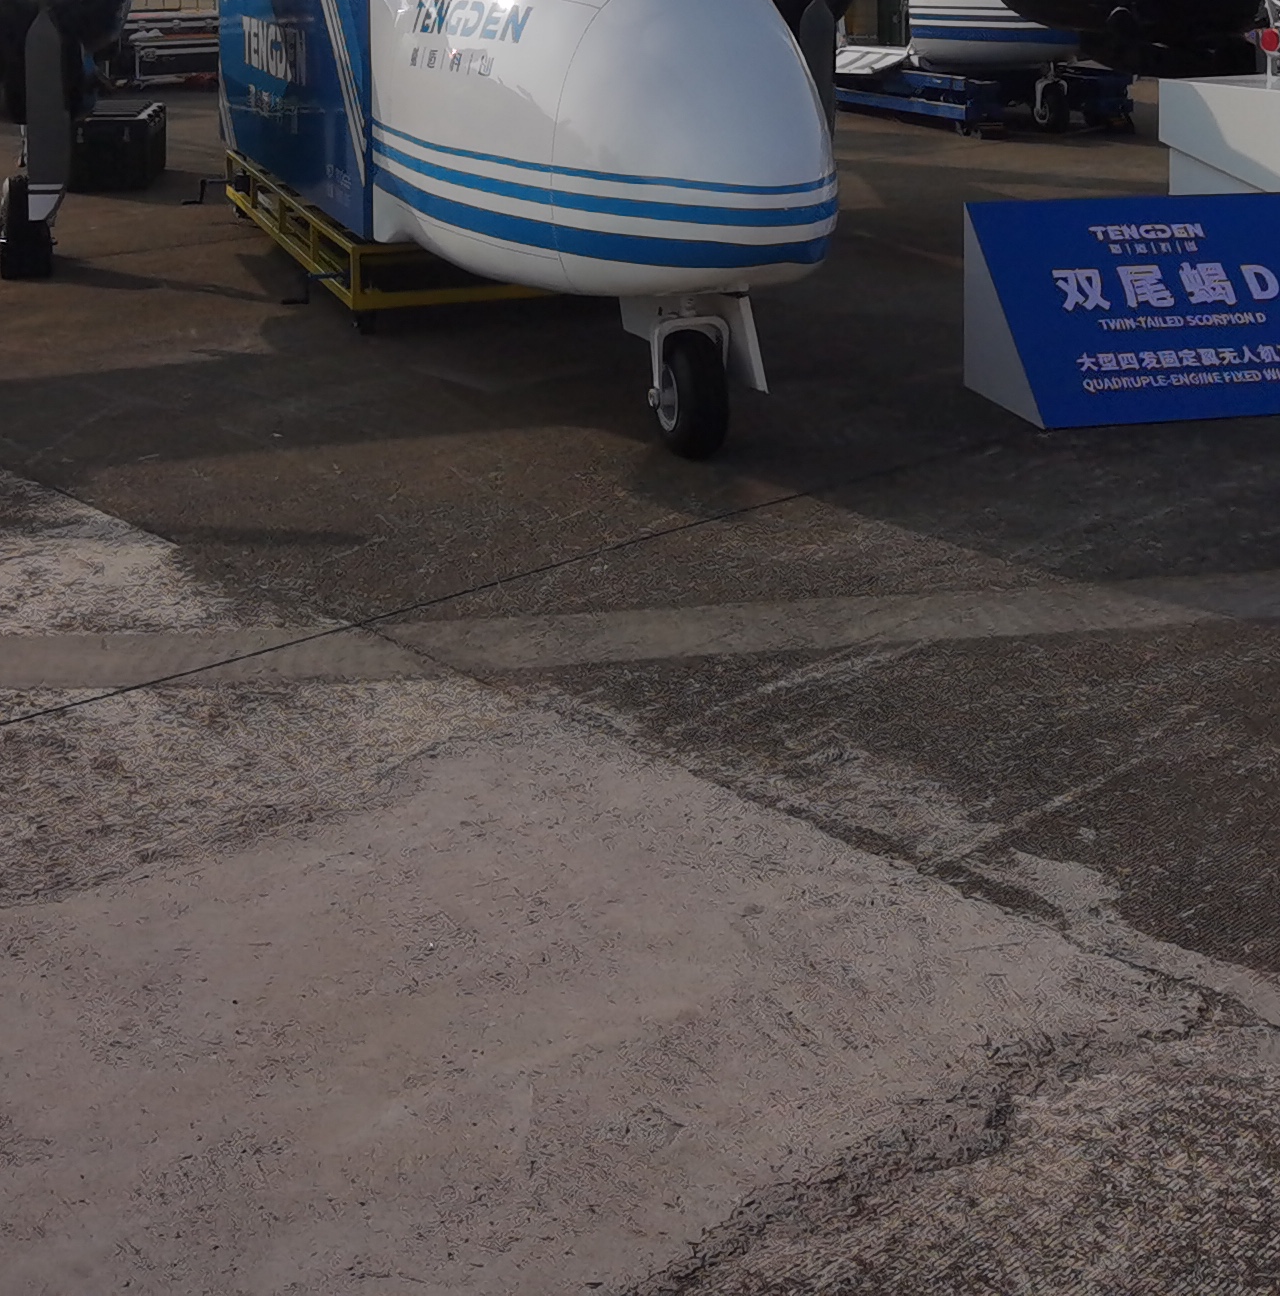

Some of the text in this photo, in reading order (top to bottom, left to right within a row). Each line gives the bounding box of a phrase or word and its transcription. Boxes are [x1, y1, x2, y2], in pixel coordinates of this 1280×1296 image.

[1088, 222, 1206, 242] TENGDEN
[1098, 311, 1267, 332] TWIN-TAILED SCORPION D
[1082, 371, 1221, 394] QUADRUPLE-ENGINE
[1223, 368, 1262, 383] FIXED
